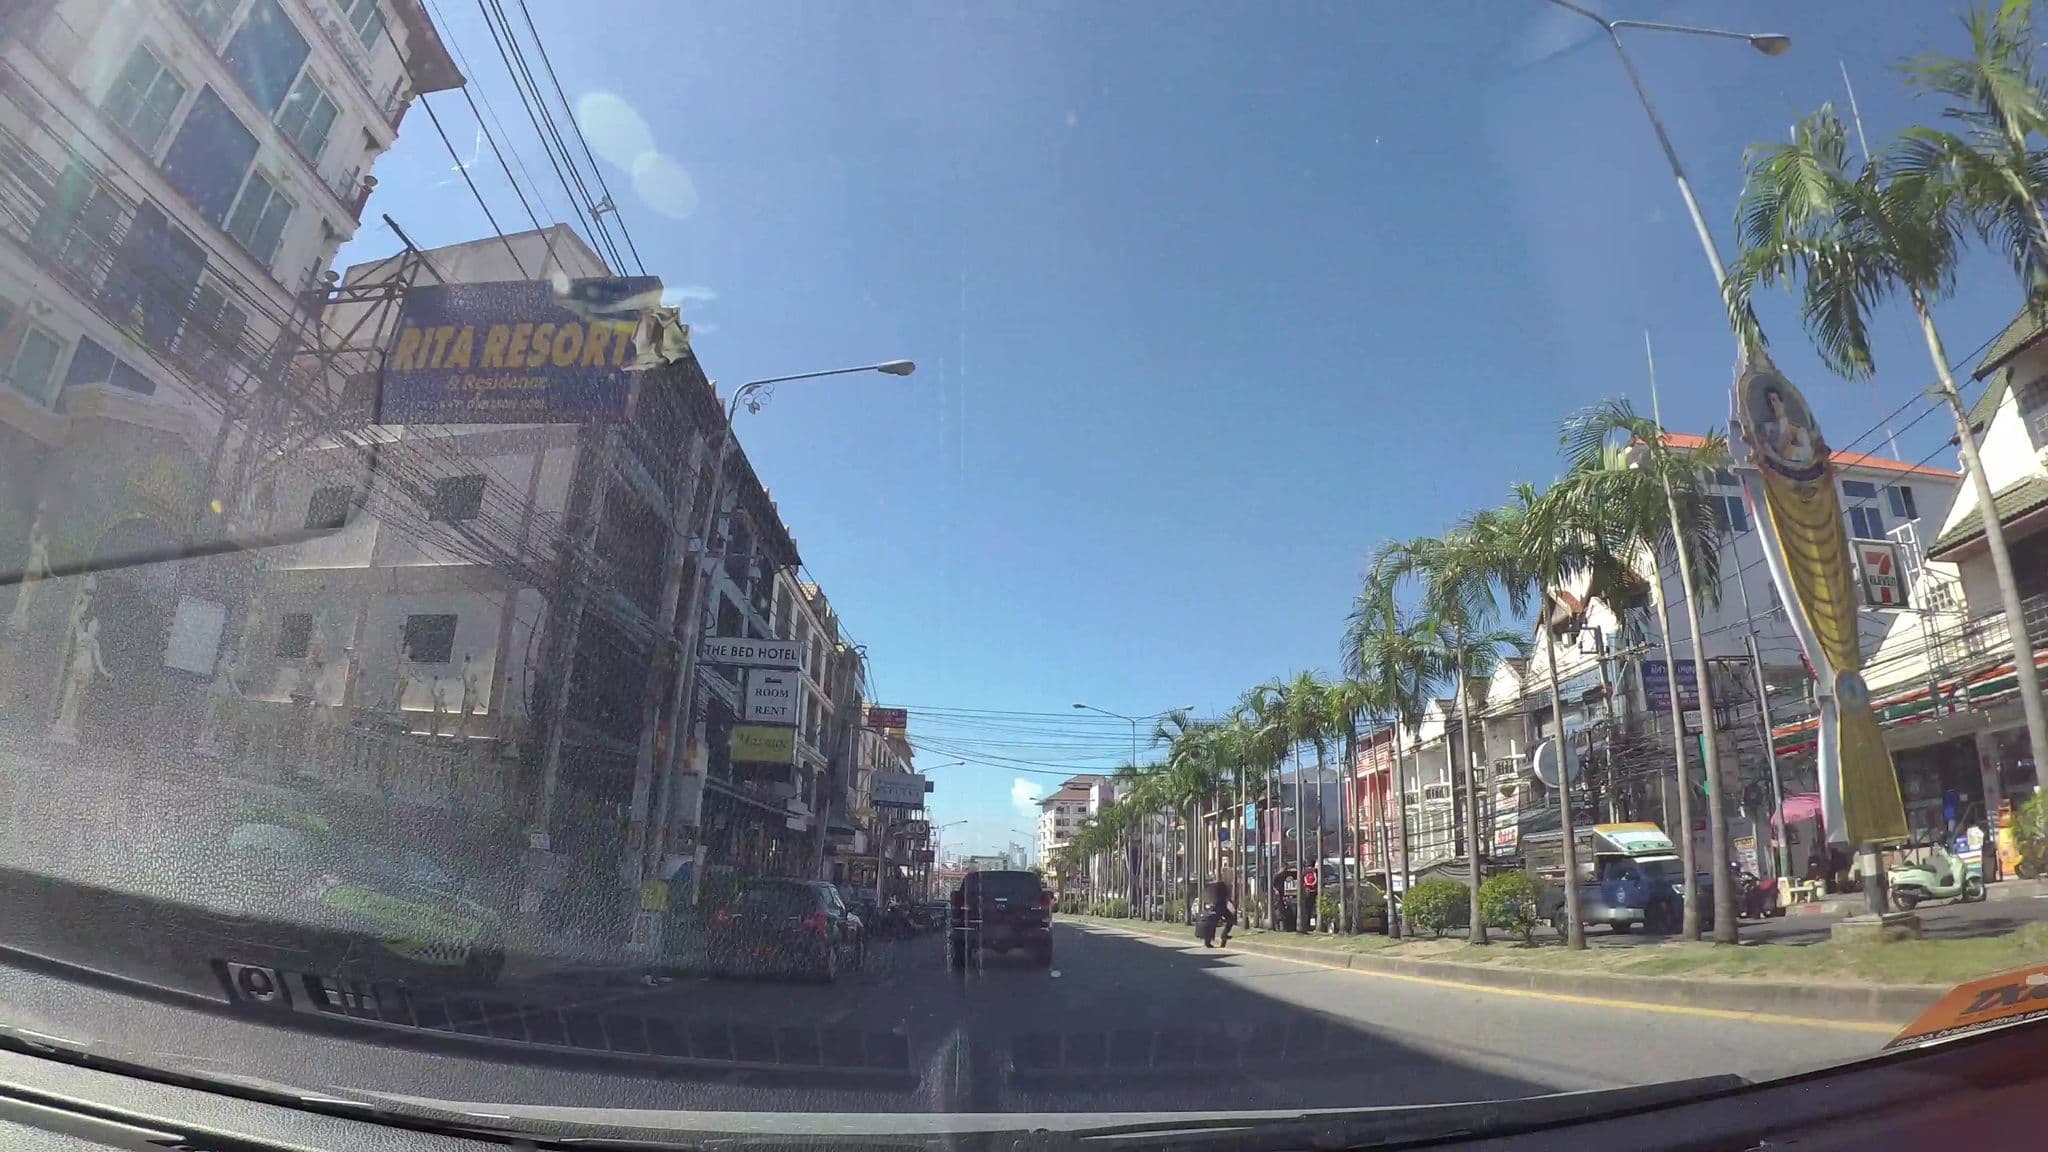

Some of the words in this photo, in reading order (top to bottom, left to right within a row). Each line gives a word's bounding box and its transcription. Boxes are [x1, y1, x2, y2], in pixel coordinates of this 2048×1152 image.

[392, 325, 474, 371] RITA
[481, 321, 635, 369] RESORT
[1865, 551, 1892, 575] 7
[706, 644, 727, 656] THE
[731, 645, 754, 658] BED
[758, 647, 797, 660] HOTEL
[755, 688, 789, 698] ROOM
[755, 705, 787, 716] RENT
